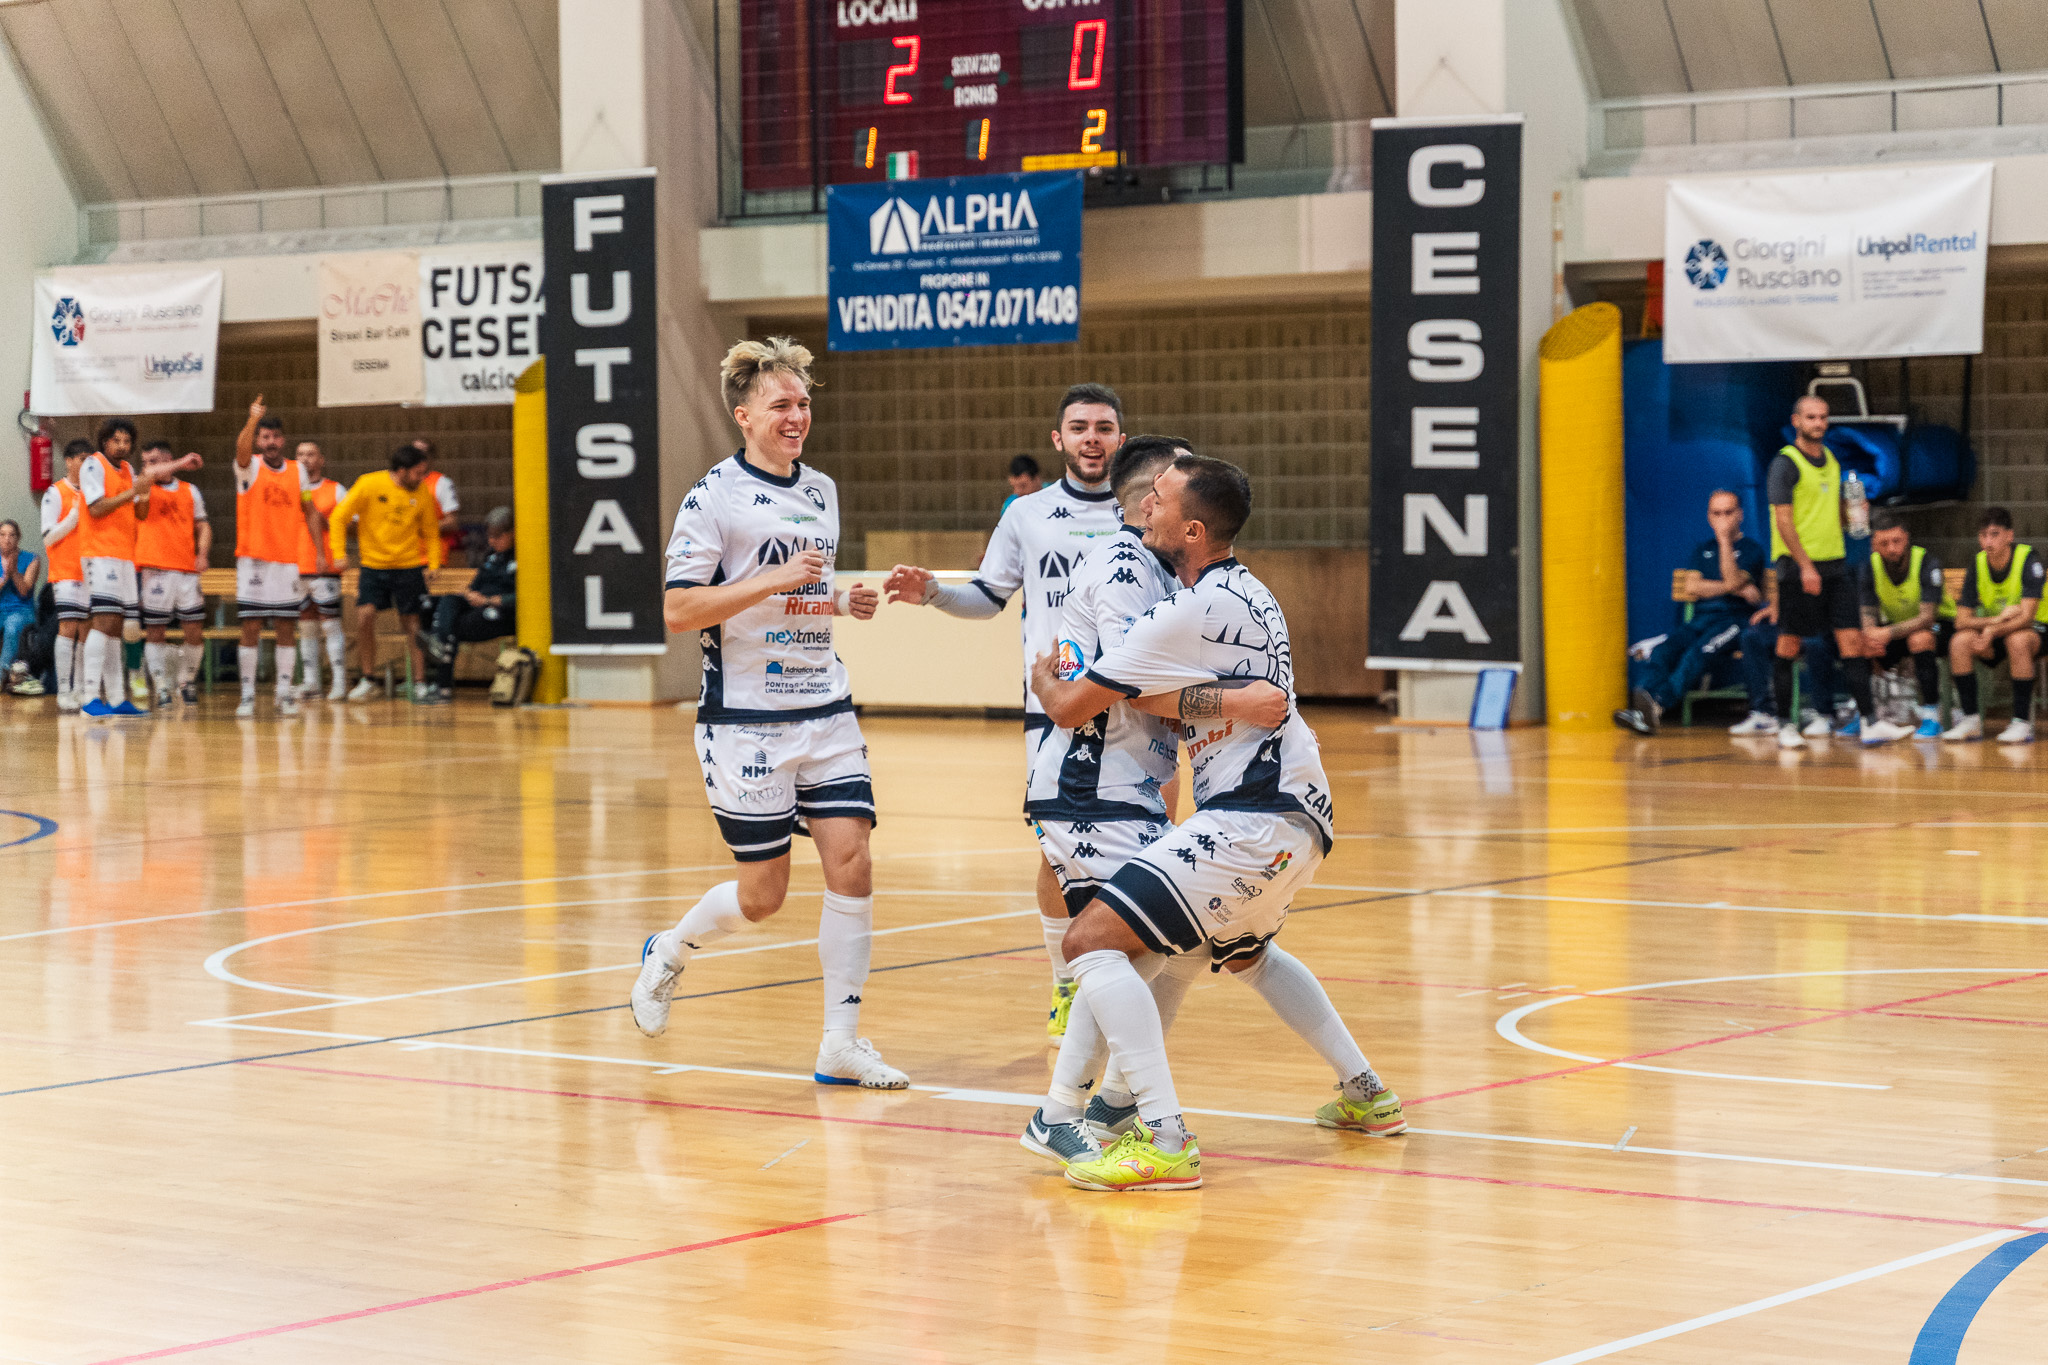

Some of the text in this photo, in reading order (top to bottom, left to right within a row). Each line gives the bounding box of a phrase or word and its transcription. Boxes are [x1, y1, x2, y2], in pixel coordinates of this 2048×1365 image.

[837, 0, 918, 27] LOCALI
[1068, 19, 1107, 90] 0
[883, 35, 920, 104] 2
[953, 83, 998, 107] BONUS
[1081, 109, 1107, 153] 2
[921, 189, 1039, 234] ALPHA
[1733, 235, 1826, 263] Giorgini
[975, 270, 990, 286] IN
[1736, 266, 1841, 290] Rusciano
[837, 285, 1078, 333] VENDITA 0547.071408
[422, 315, 541, 360] CESE
[461, 367, 515, 391] calcio
[1400, 144, 1492, 643] CESENA
[570, 194, 644, 630] FUTSAL
[790, 536, 836, 556] ALPH
[783, 597, 835, 616] Ricamb
[737, 784, 785, 804] HORTUS
